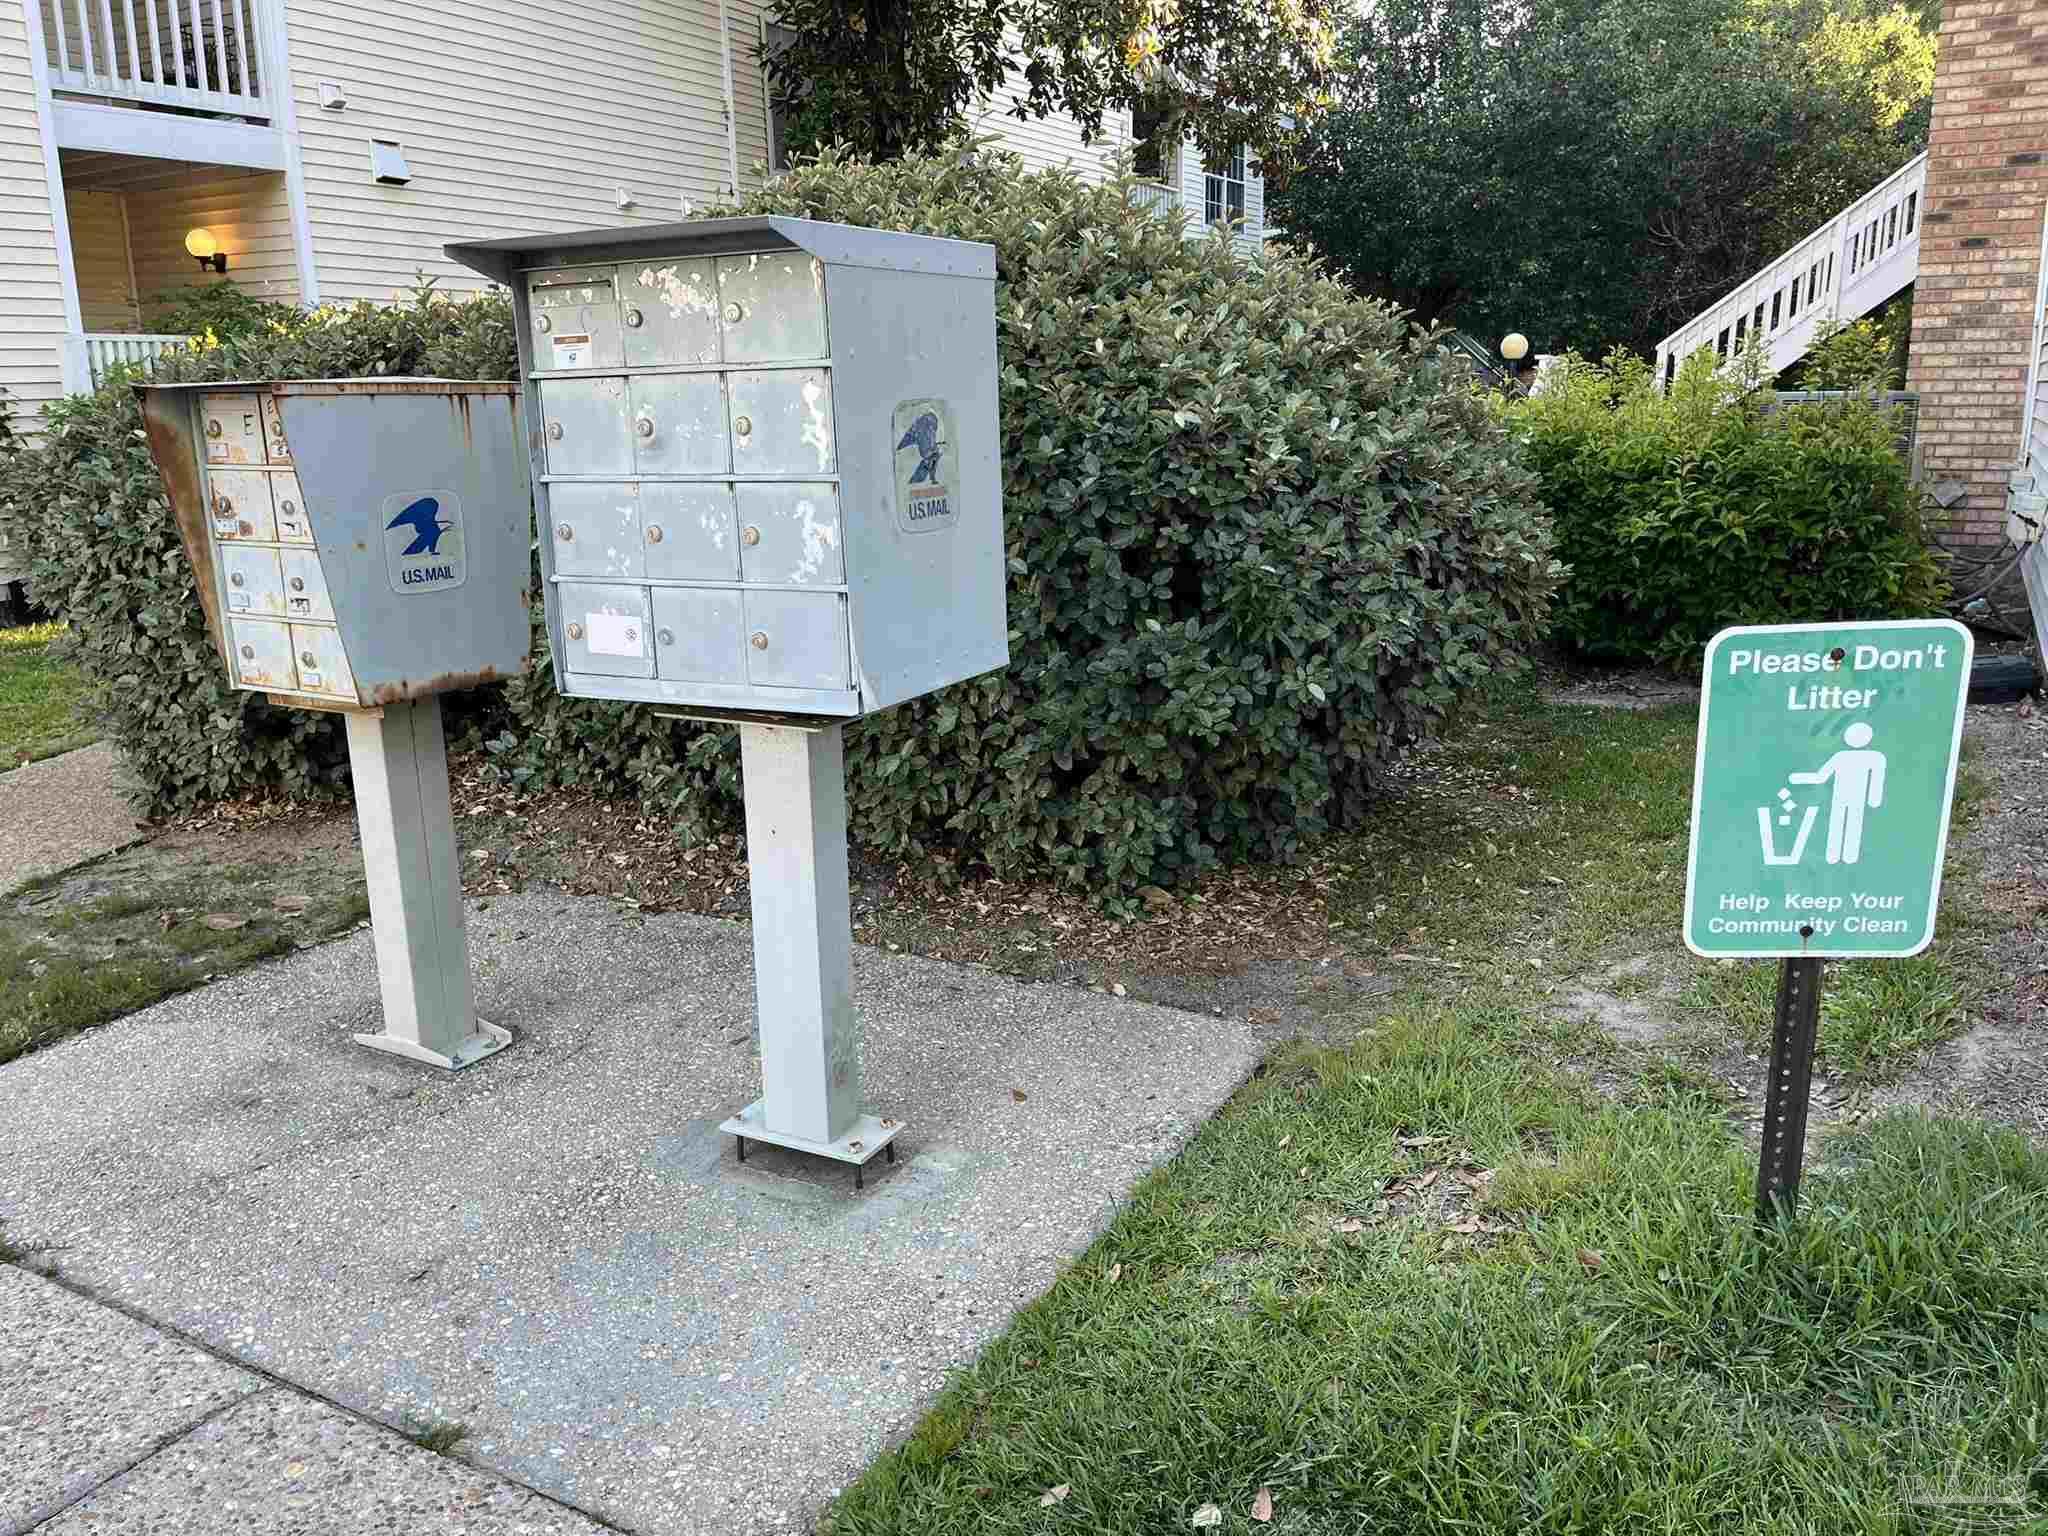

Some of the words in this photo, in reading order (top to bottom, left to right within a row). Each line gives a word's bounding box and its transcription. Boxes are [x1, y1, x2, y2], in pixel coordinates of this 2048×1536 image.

[1729, 648, 1843, 676] Please
[1854, 643, 1947, 671] Don't
[1787, 685, 1878, 711] Litter
[1719, 893, 1770, 913] Help
[1785, 893, 1842, 912] Keep
[1850, 892, 1905, 910] Your
[1708, 916, 1836, 937] Community
[1843, 916, 1909, 934] Clean
